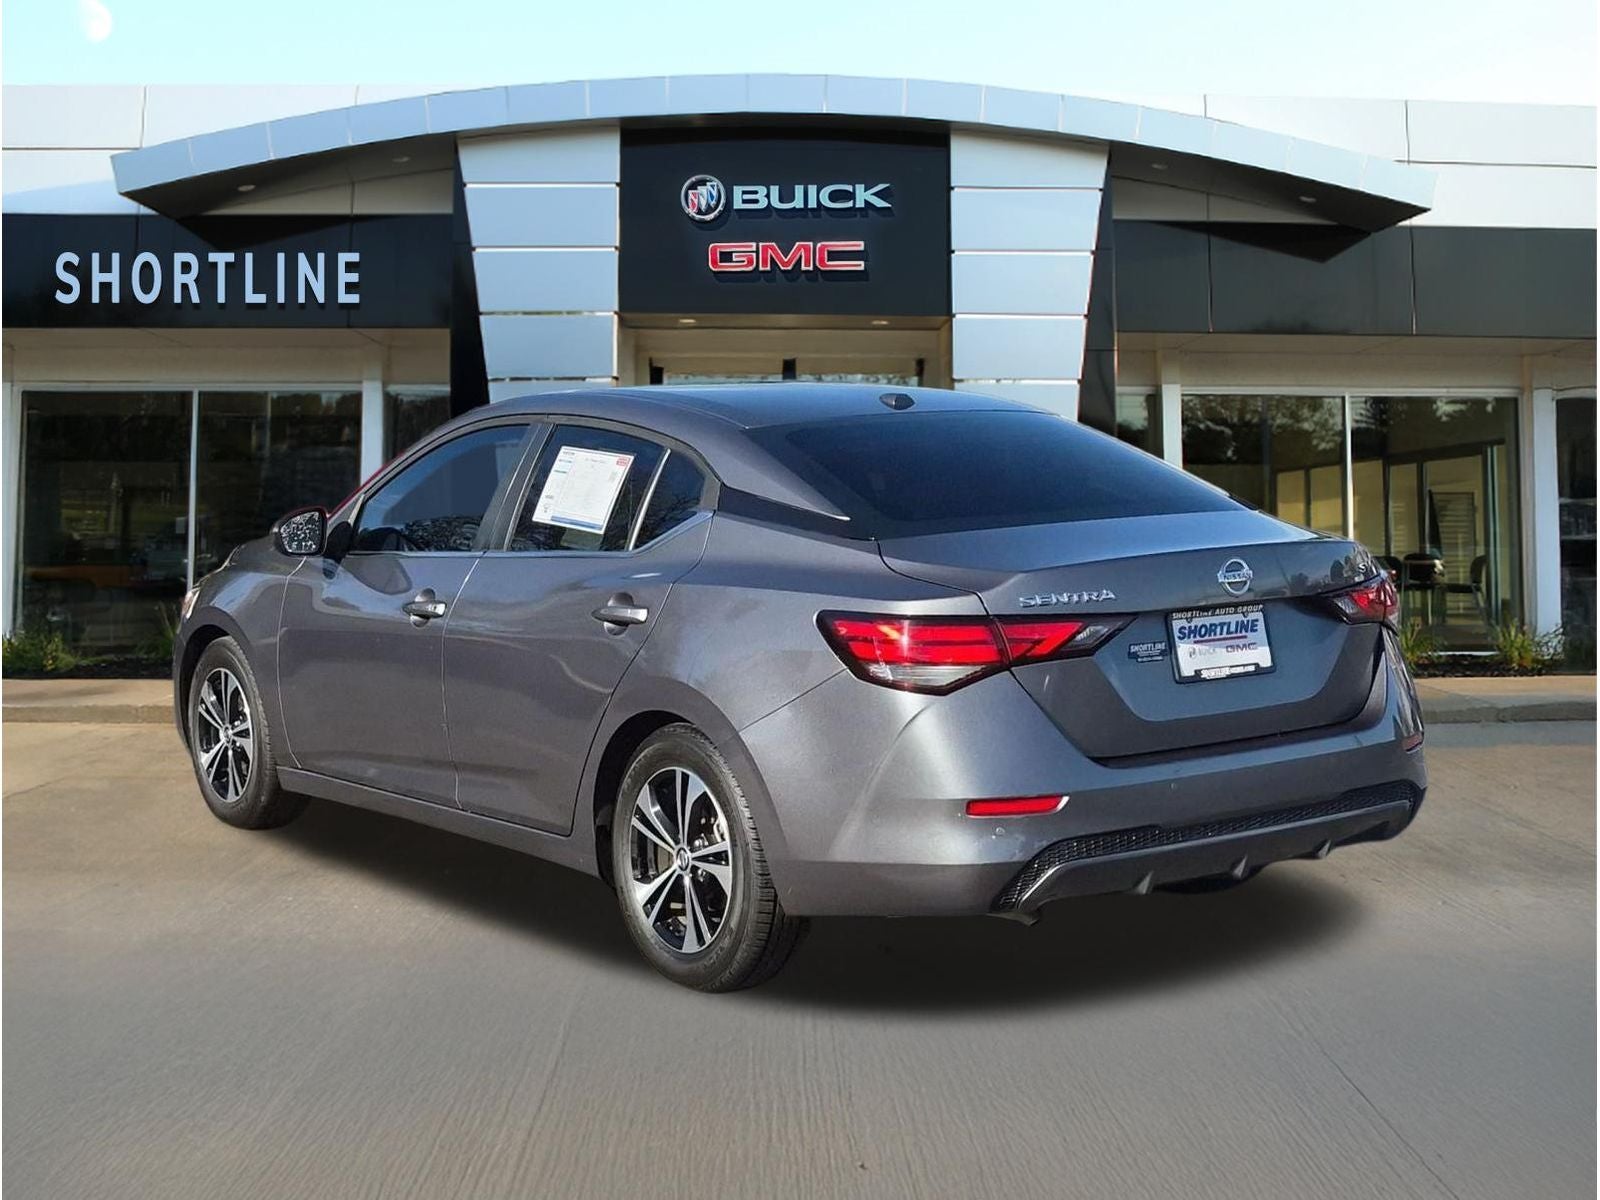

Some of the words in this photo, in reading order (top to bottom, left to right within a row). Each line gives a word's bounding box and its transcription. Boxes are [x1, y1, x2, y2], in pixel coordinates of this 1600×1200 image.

[733, 183, 892, 209] BUICK
[708, 240, 865, 272] GMC
[55, 251, 361, 304] SHORTLINE
[1223, 570, 1251, 581] NISSAN
[1019, 589, 1116, 608] SENTRA
[1214, 606, 1235, 615] AUTO
[1237, 604, 1263, 613] GROUP
[1177, 619, 1259, 640] SHORTLINE
[1226, 642, 1257, 653] GMC
